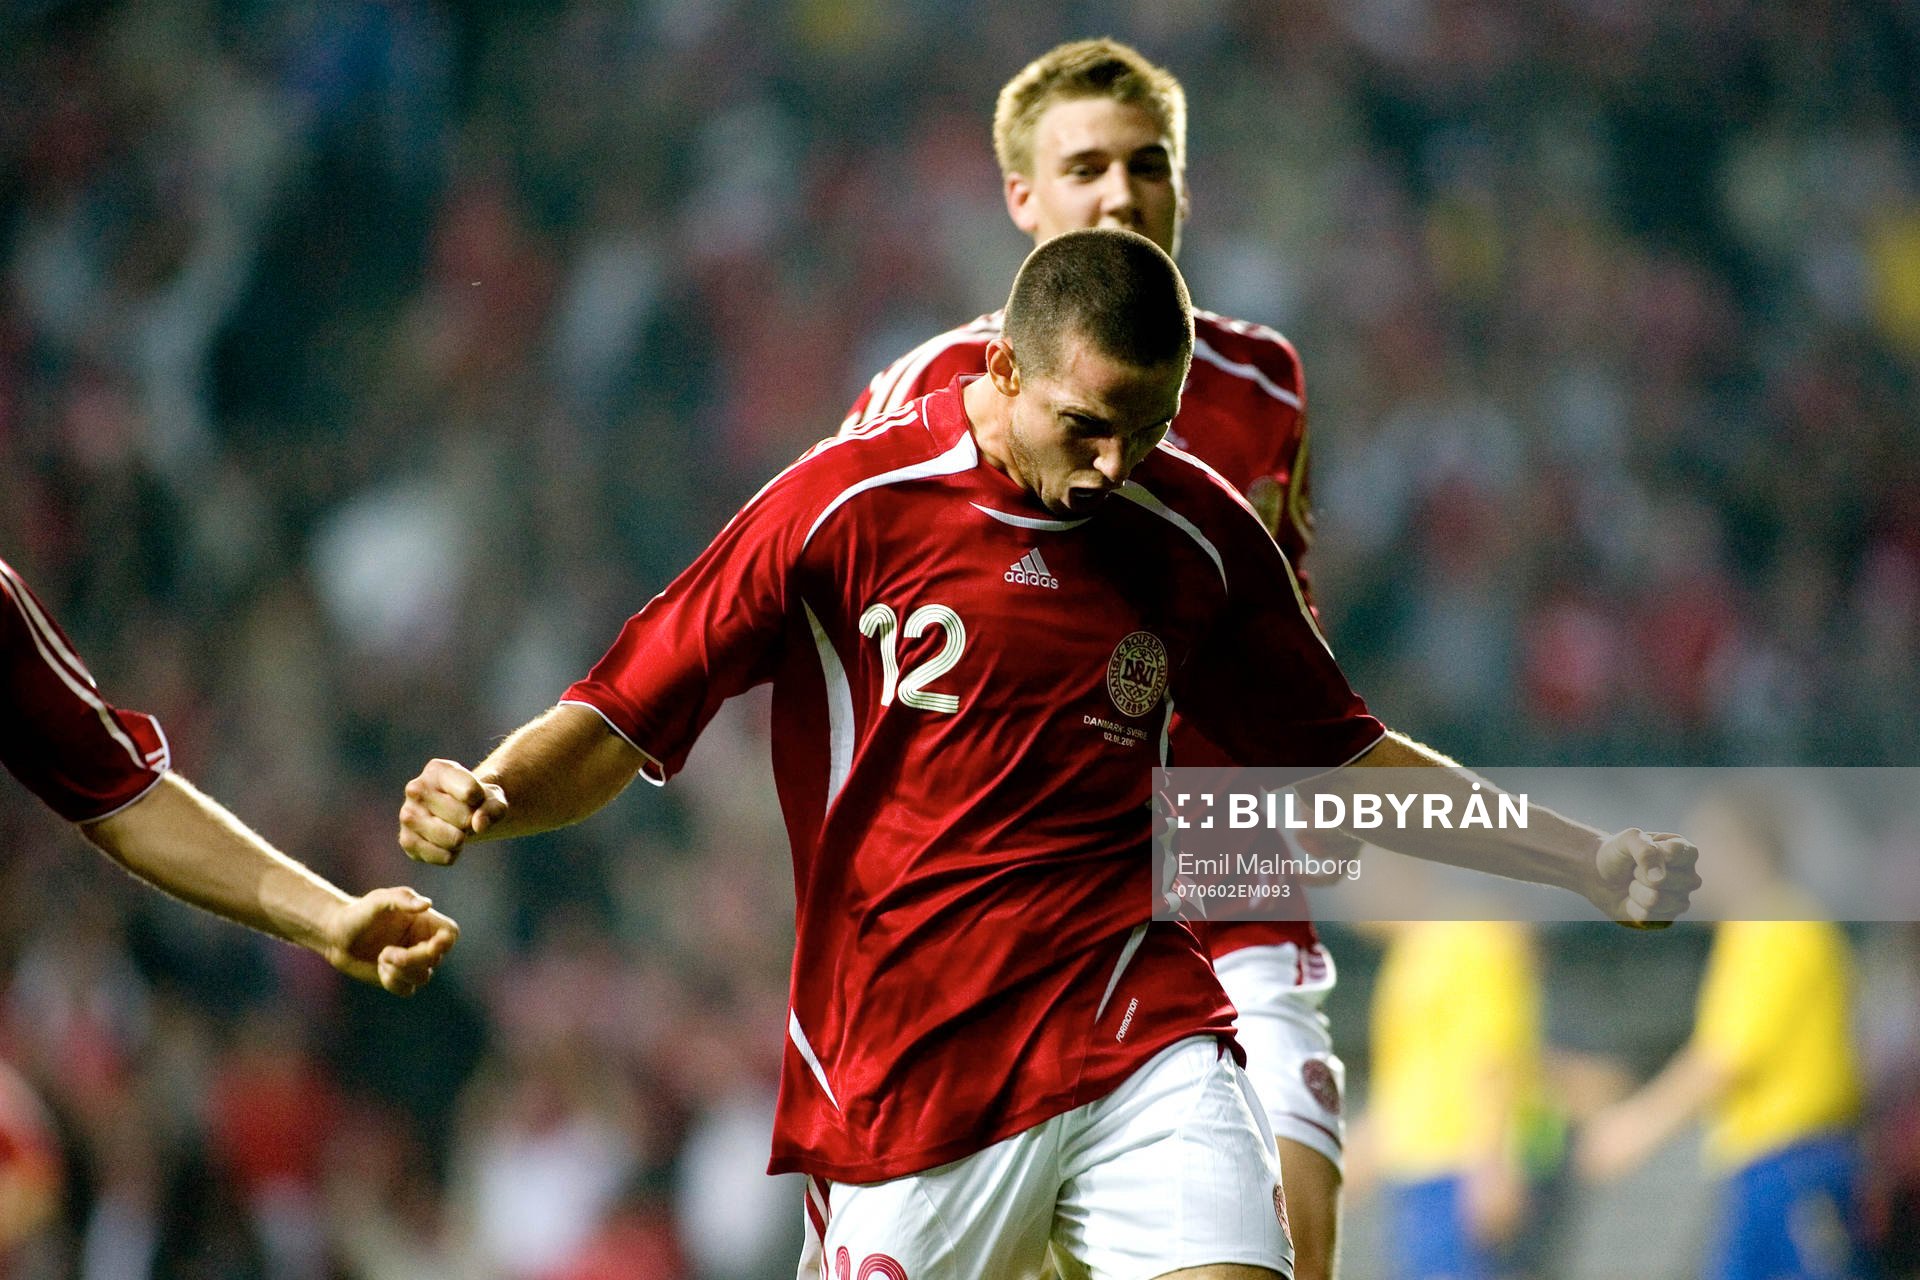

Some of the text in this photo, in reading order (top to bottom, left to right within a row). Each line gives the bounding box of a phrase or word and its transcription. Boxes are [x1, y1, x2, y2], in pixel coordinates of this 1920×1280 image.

[1004, 570, 1059, 589] adidas
[859, 603, 966, 713] 12
[1120, 697, 1143, 713] 1889
